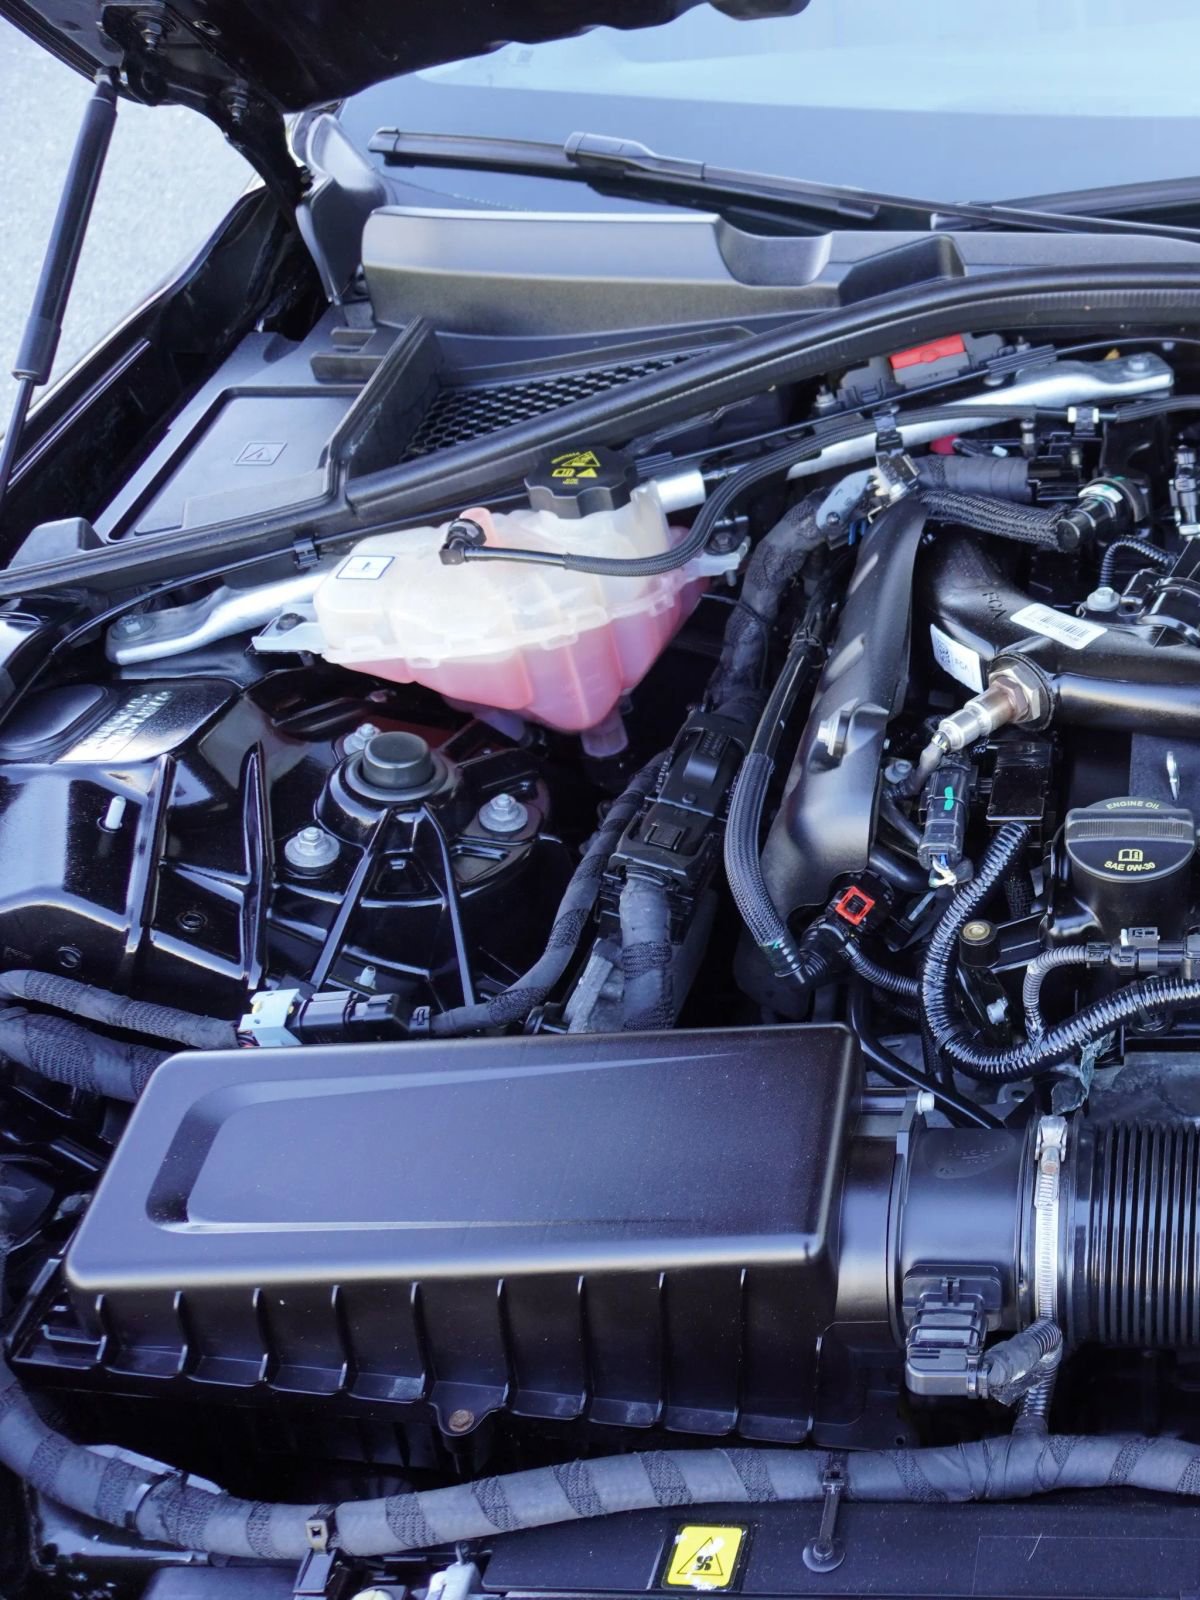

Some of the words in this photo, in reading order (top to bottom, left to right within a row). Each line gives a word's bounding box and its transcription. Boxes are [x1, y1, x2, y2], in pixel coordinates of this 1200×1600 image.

[1106, 800, 1142, 809] ENGINE
[1145, 801, 1160, 809] OIL
[1104, 860, 1125, 871] SAE
[1126, 862, 1156, 872] 0W-30
